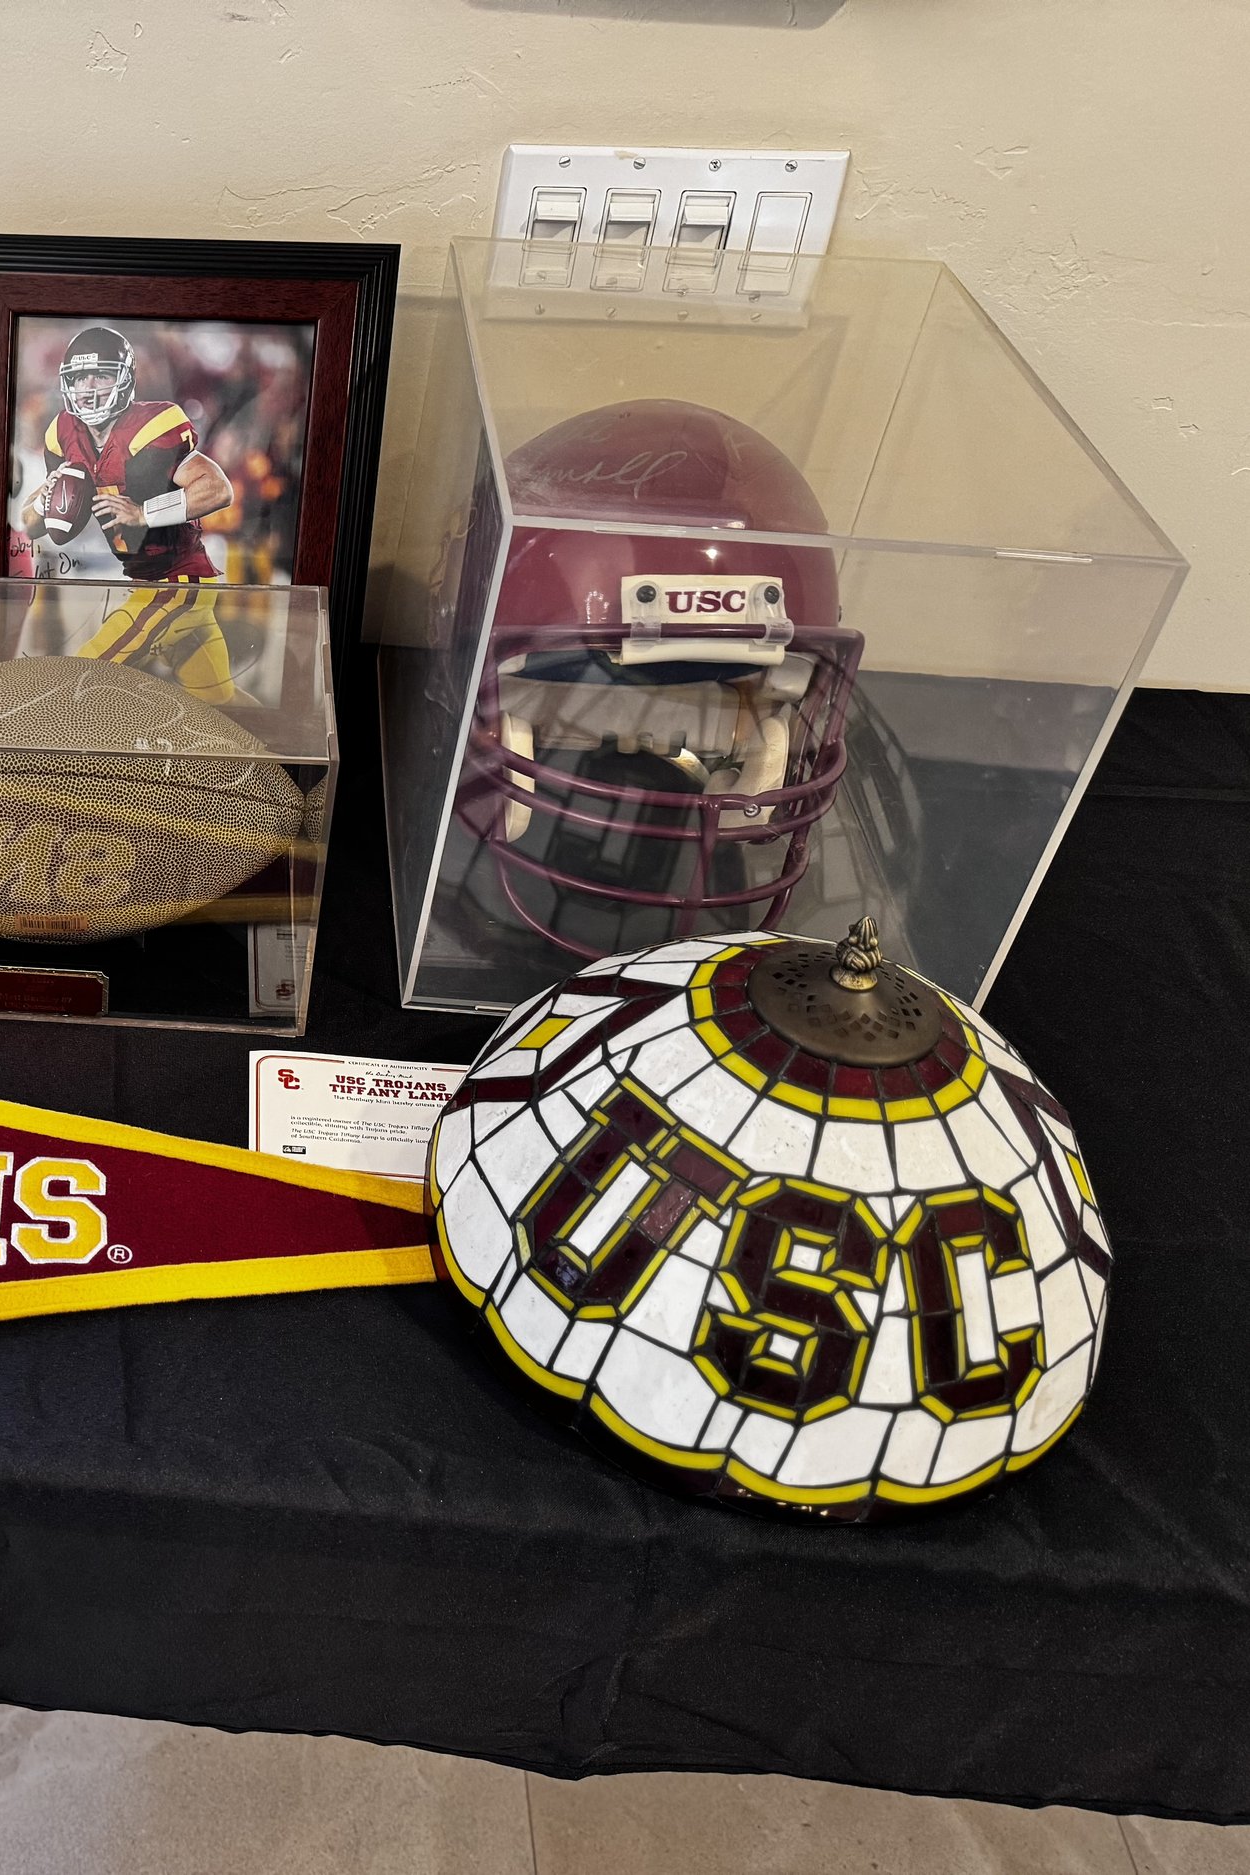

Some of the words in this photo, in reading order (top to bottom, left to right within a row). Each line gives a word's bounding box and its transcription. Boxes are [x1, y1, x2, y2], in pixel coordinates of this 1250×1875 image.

[9, 537, 41, 558] oby,
[665, 589, 746, 614] USC
[277, 1068, 301, 1090] SC
[335, 1074, 366, 1086] USC
[372, 1078, 447, 1092] TROJANS
[329, 1083, 401, 1099] TIFFANY
[512, 1075, 1045, 1424] USC
